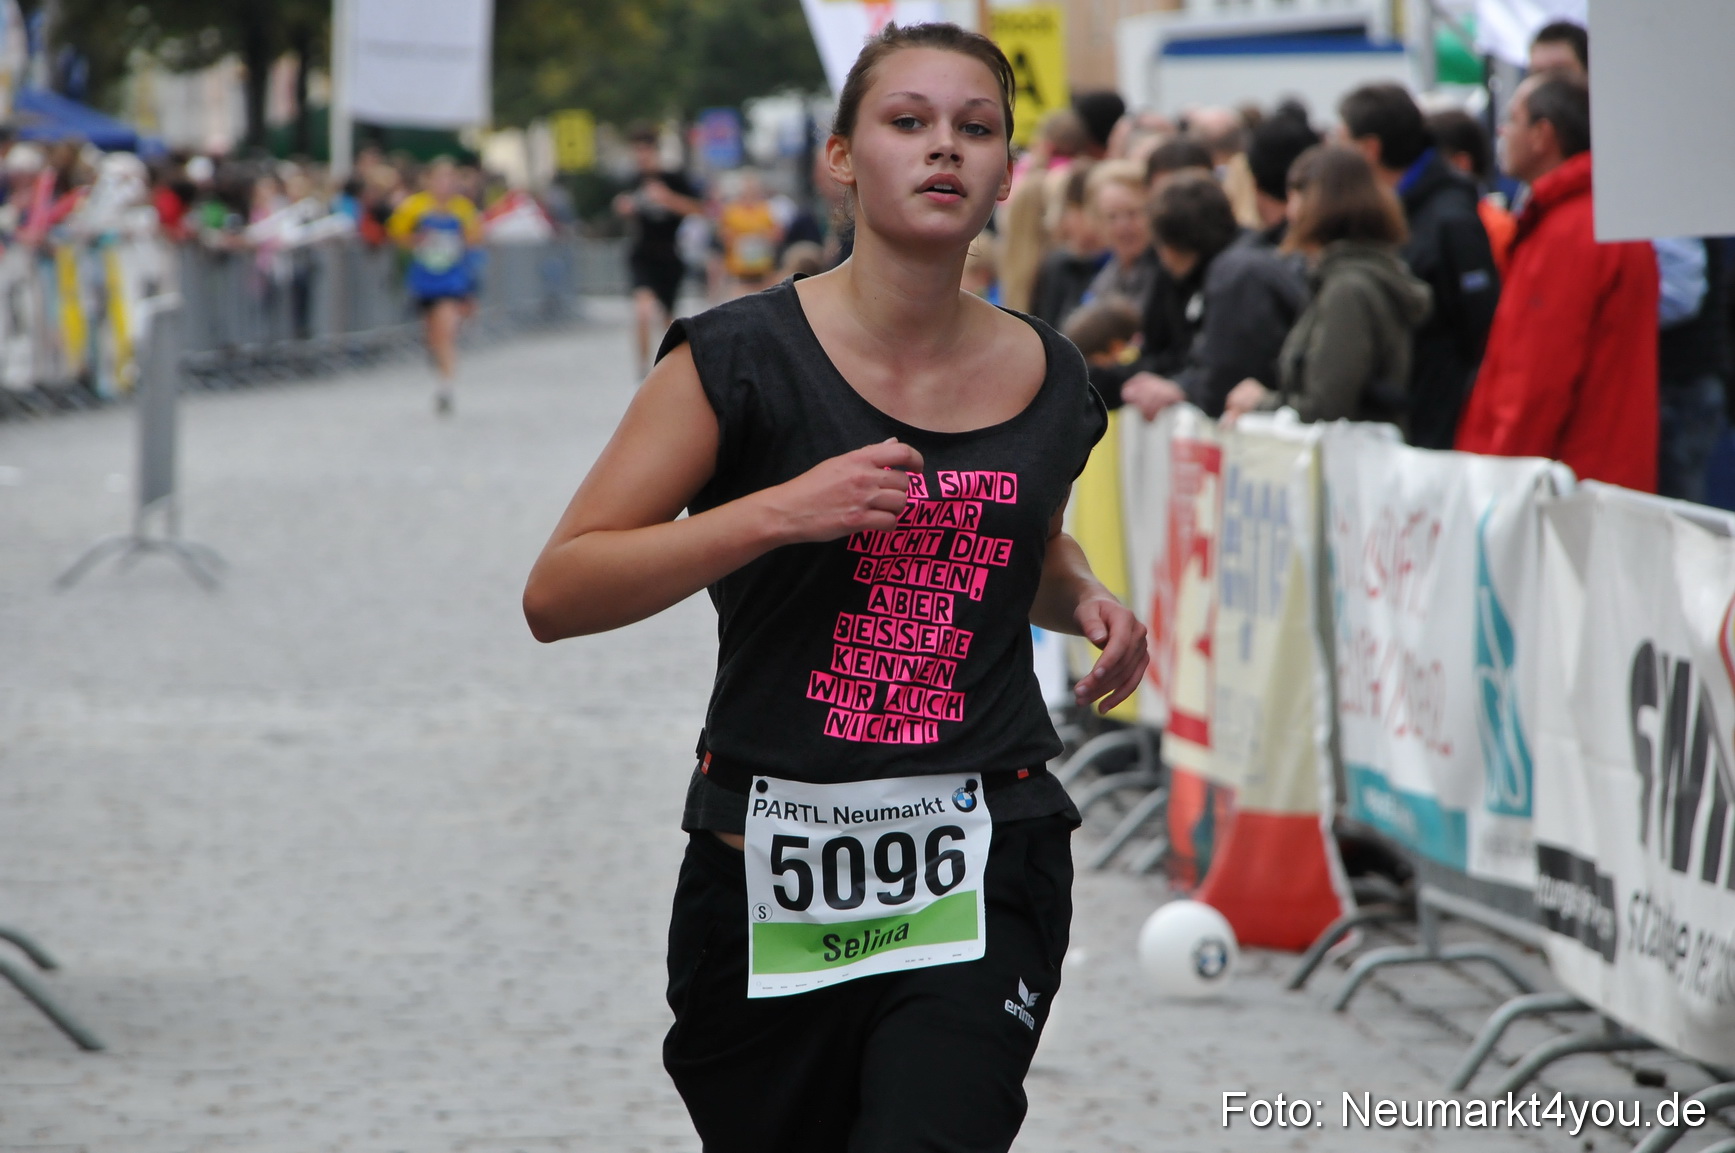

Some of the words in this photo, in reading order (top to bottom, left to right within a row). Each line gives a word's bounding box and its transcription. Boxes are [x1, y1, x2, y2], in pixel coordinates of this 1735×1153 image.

[941, 472, 1017, 501] SIND
[898, 501, 980, 530] ZWAR
[850, 530, 942, 553] NICHT
[951, 533, 1012, 565] DIE
[856, 557, 985, 599] BESTEN,
[869, 586, 953, 623] ABER
[835, 613, 972, 658] BESSERE
[832, 646, 956, 688] KENNEN
[809, 672, 874, 710] WIR
[885, 685, 964, 720] AUCH
[826, 710, 938, 743] NICHT!
[752, 798, 828, 825] PARTL
[832, 796, 946, 825] Neumarkt
[769, 824, 967, 912] 5096
[758, 905, 767, 920] S
[822, 921, 911, 962] Selina
[1004, 998, 1035, 1031] erima
